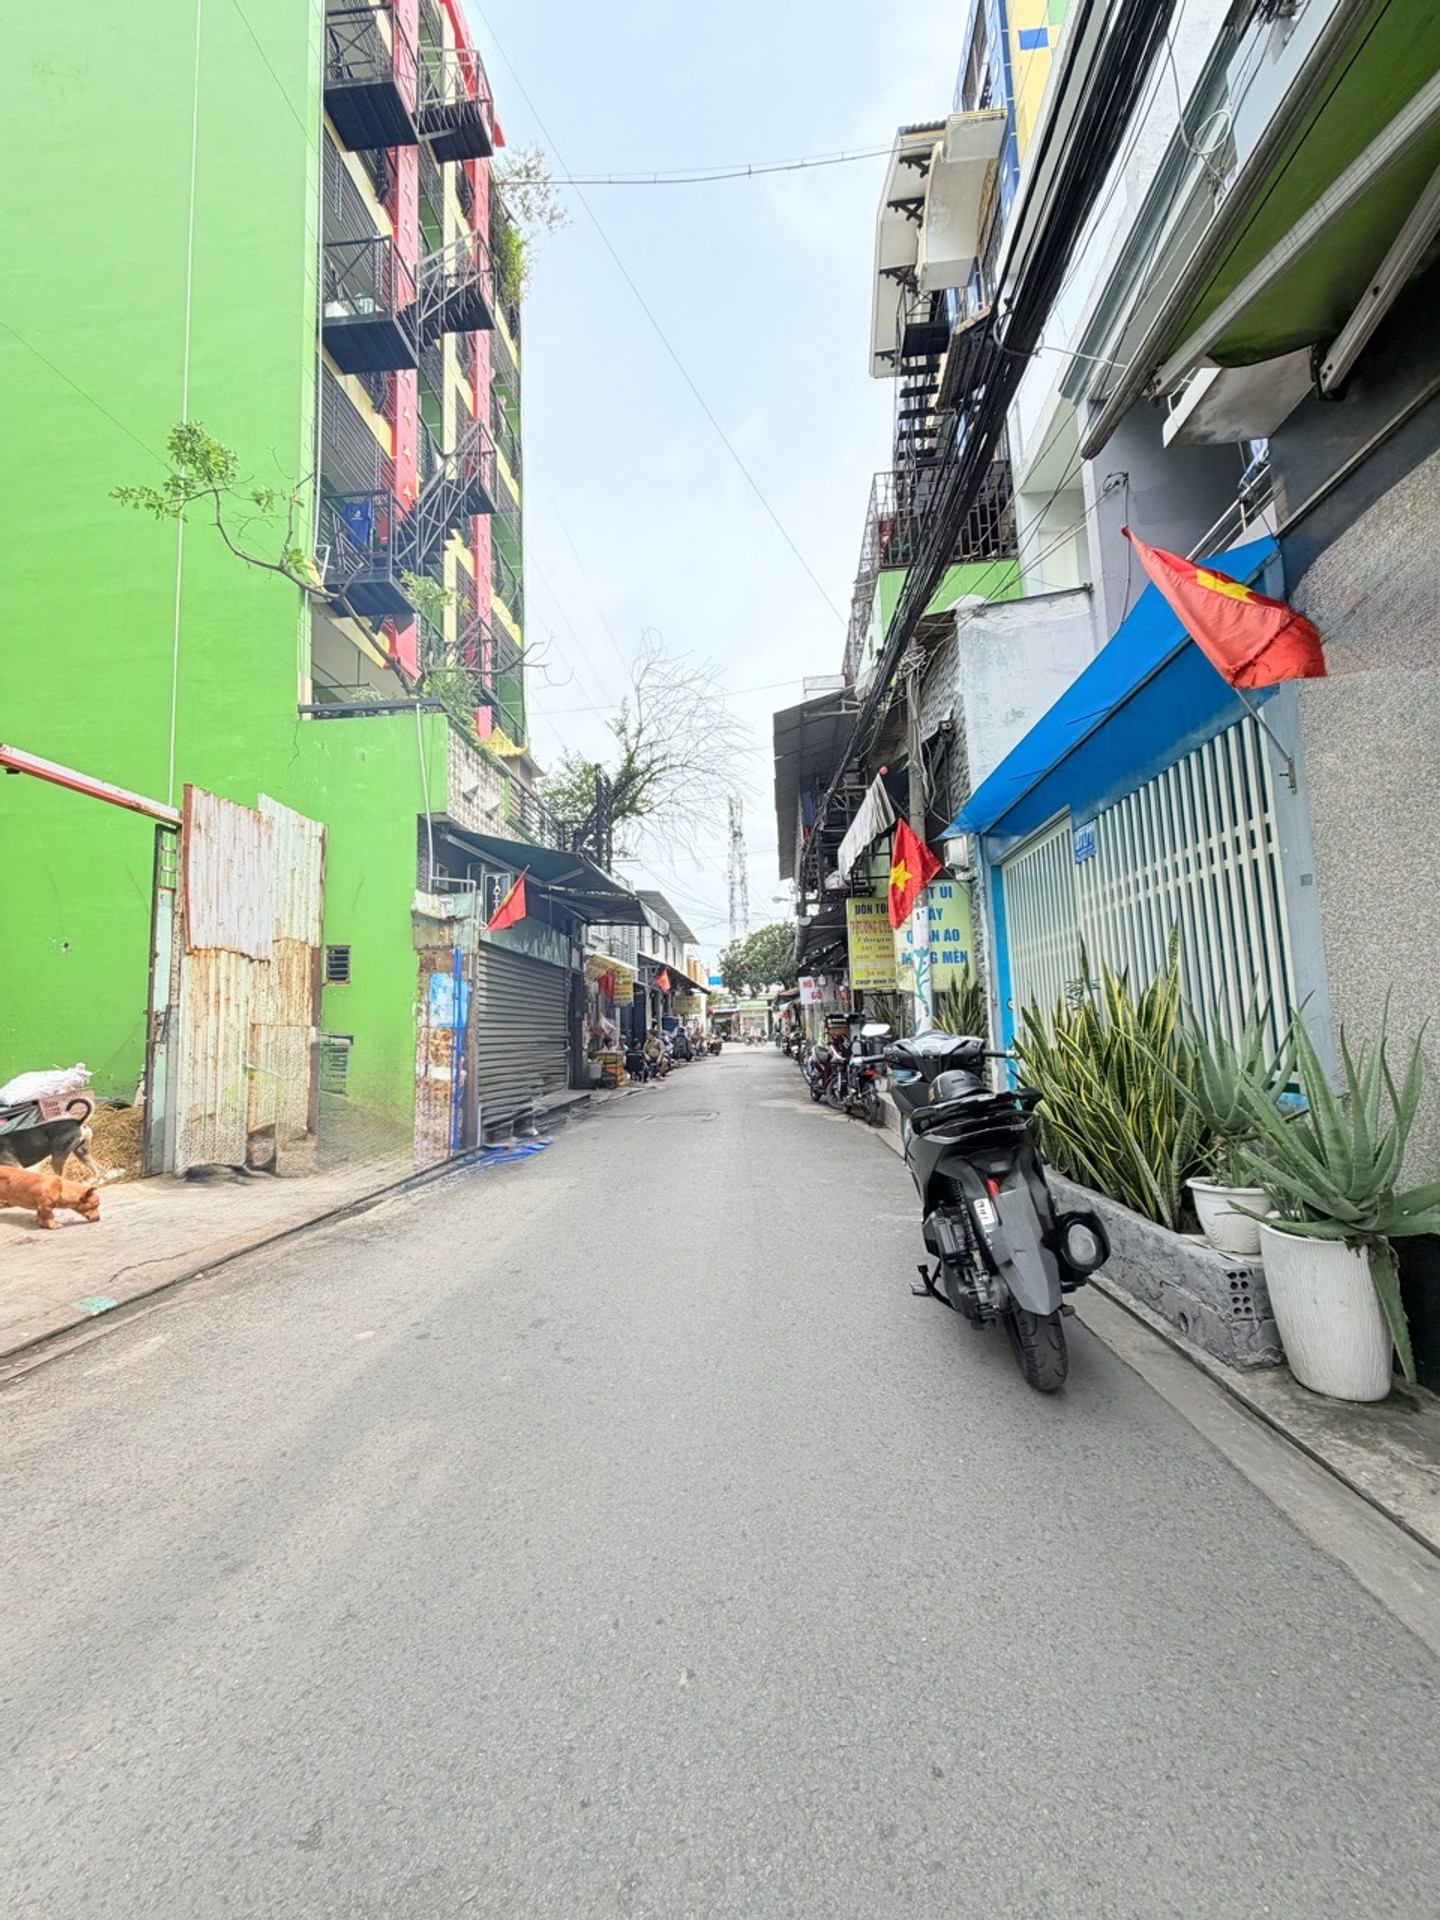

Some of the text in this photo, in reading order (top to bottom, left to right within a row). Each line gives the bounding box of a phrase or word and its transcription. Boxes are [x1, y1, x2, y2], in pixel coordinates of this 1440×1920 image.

[928, 904, 944, 921] ẤY
[906, 927, 961, 945] QN ÁO
[901, 950, 938, 965] MG
